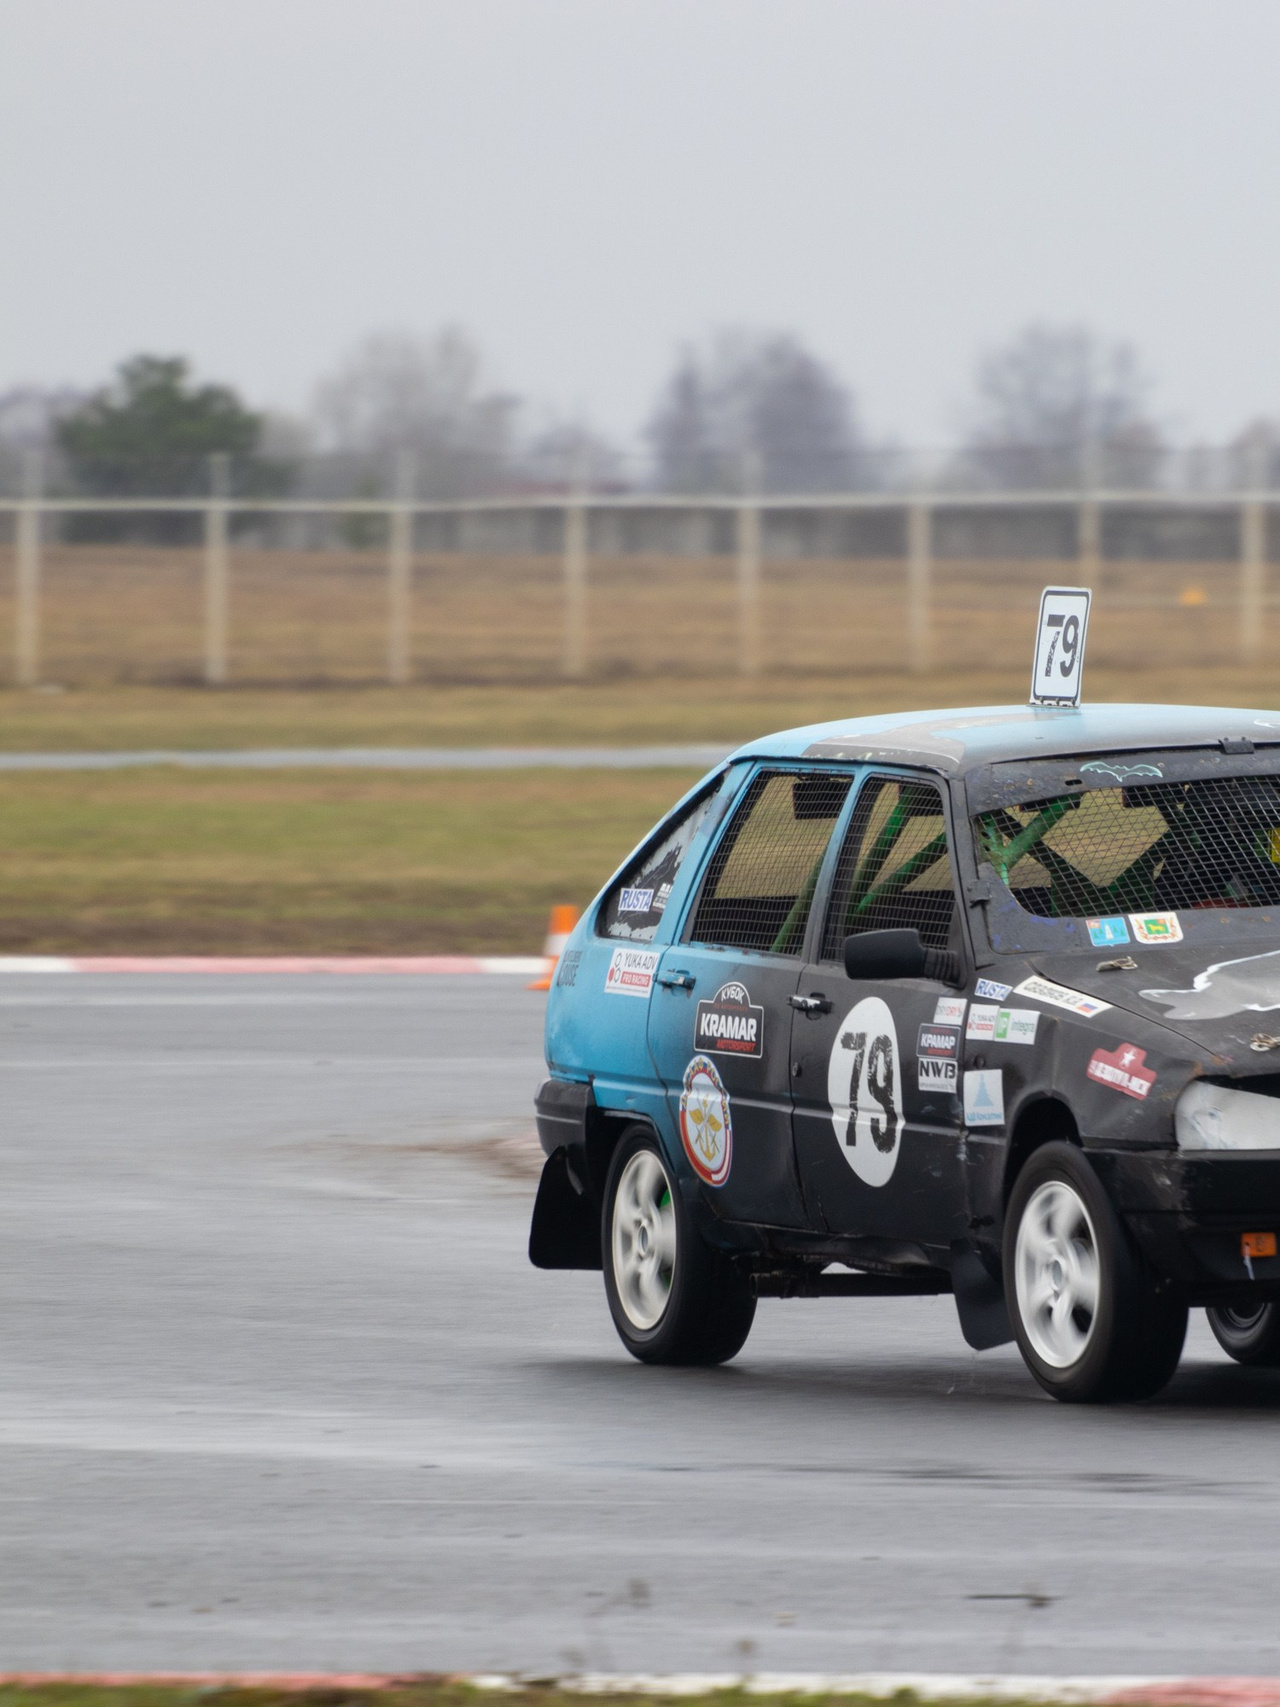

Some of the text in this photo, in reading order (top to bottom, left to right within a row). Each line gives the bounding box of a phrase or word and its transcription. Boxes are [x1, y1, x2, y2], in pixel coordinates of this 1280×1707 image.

[1045, 614, 1080, 677] 79
[620, 889, 652, 909] RUSTA
[624, 953, 659, 971] YUKA ADV
[721, 986, 745, 1004] КУБОК
[700, 1012, 757, 1041] KRAMAR
[716, 1039, 756, 1052] MOTORSPORT
[920, 1060, 956, 1079] NWB
[841, 1031, 898, 1154] 79
